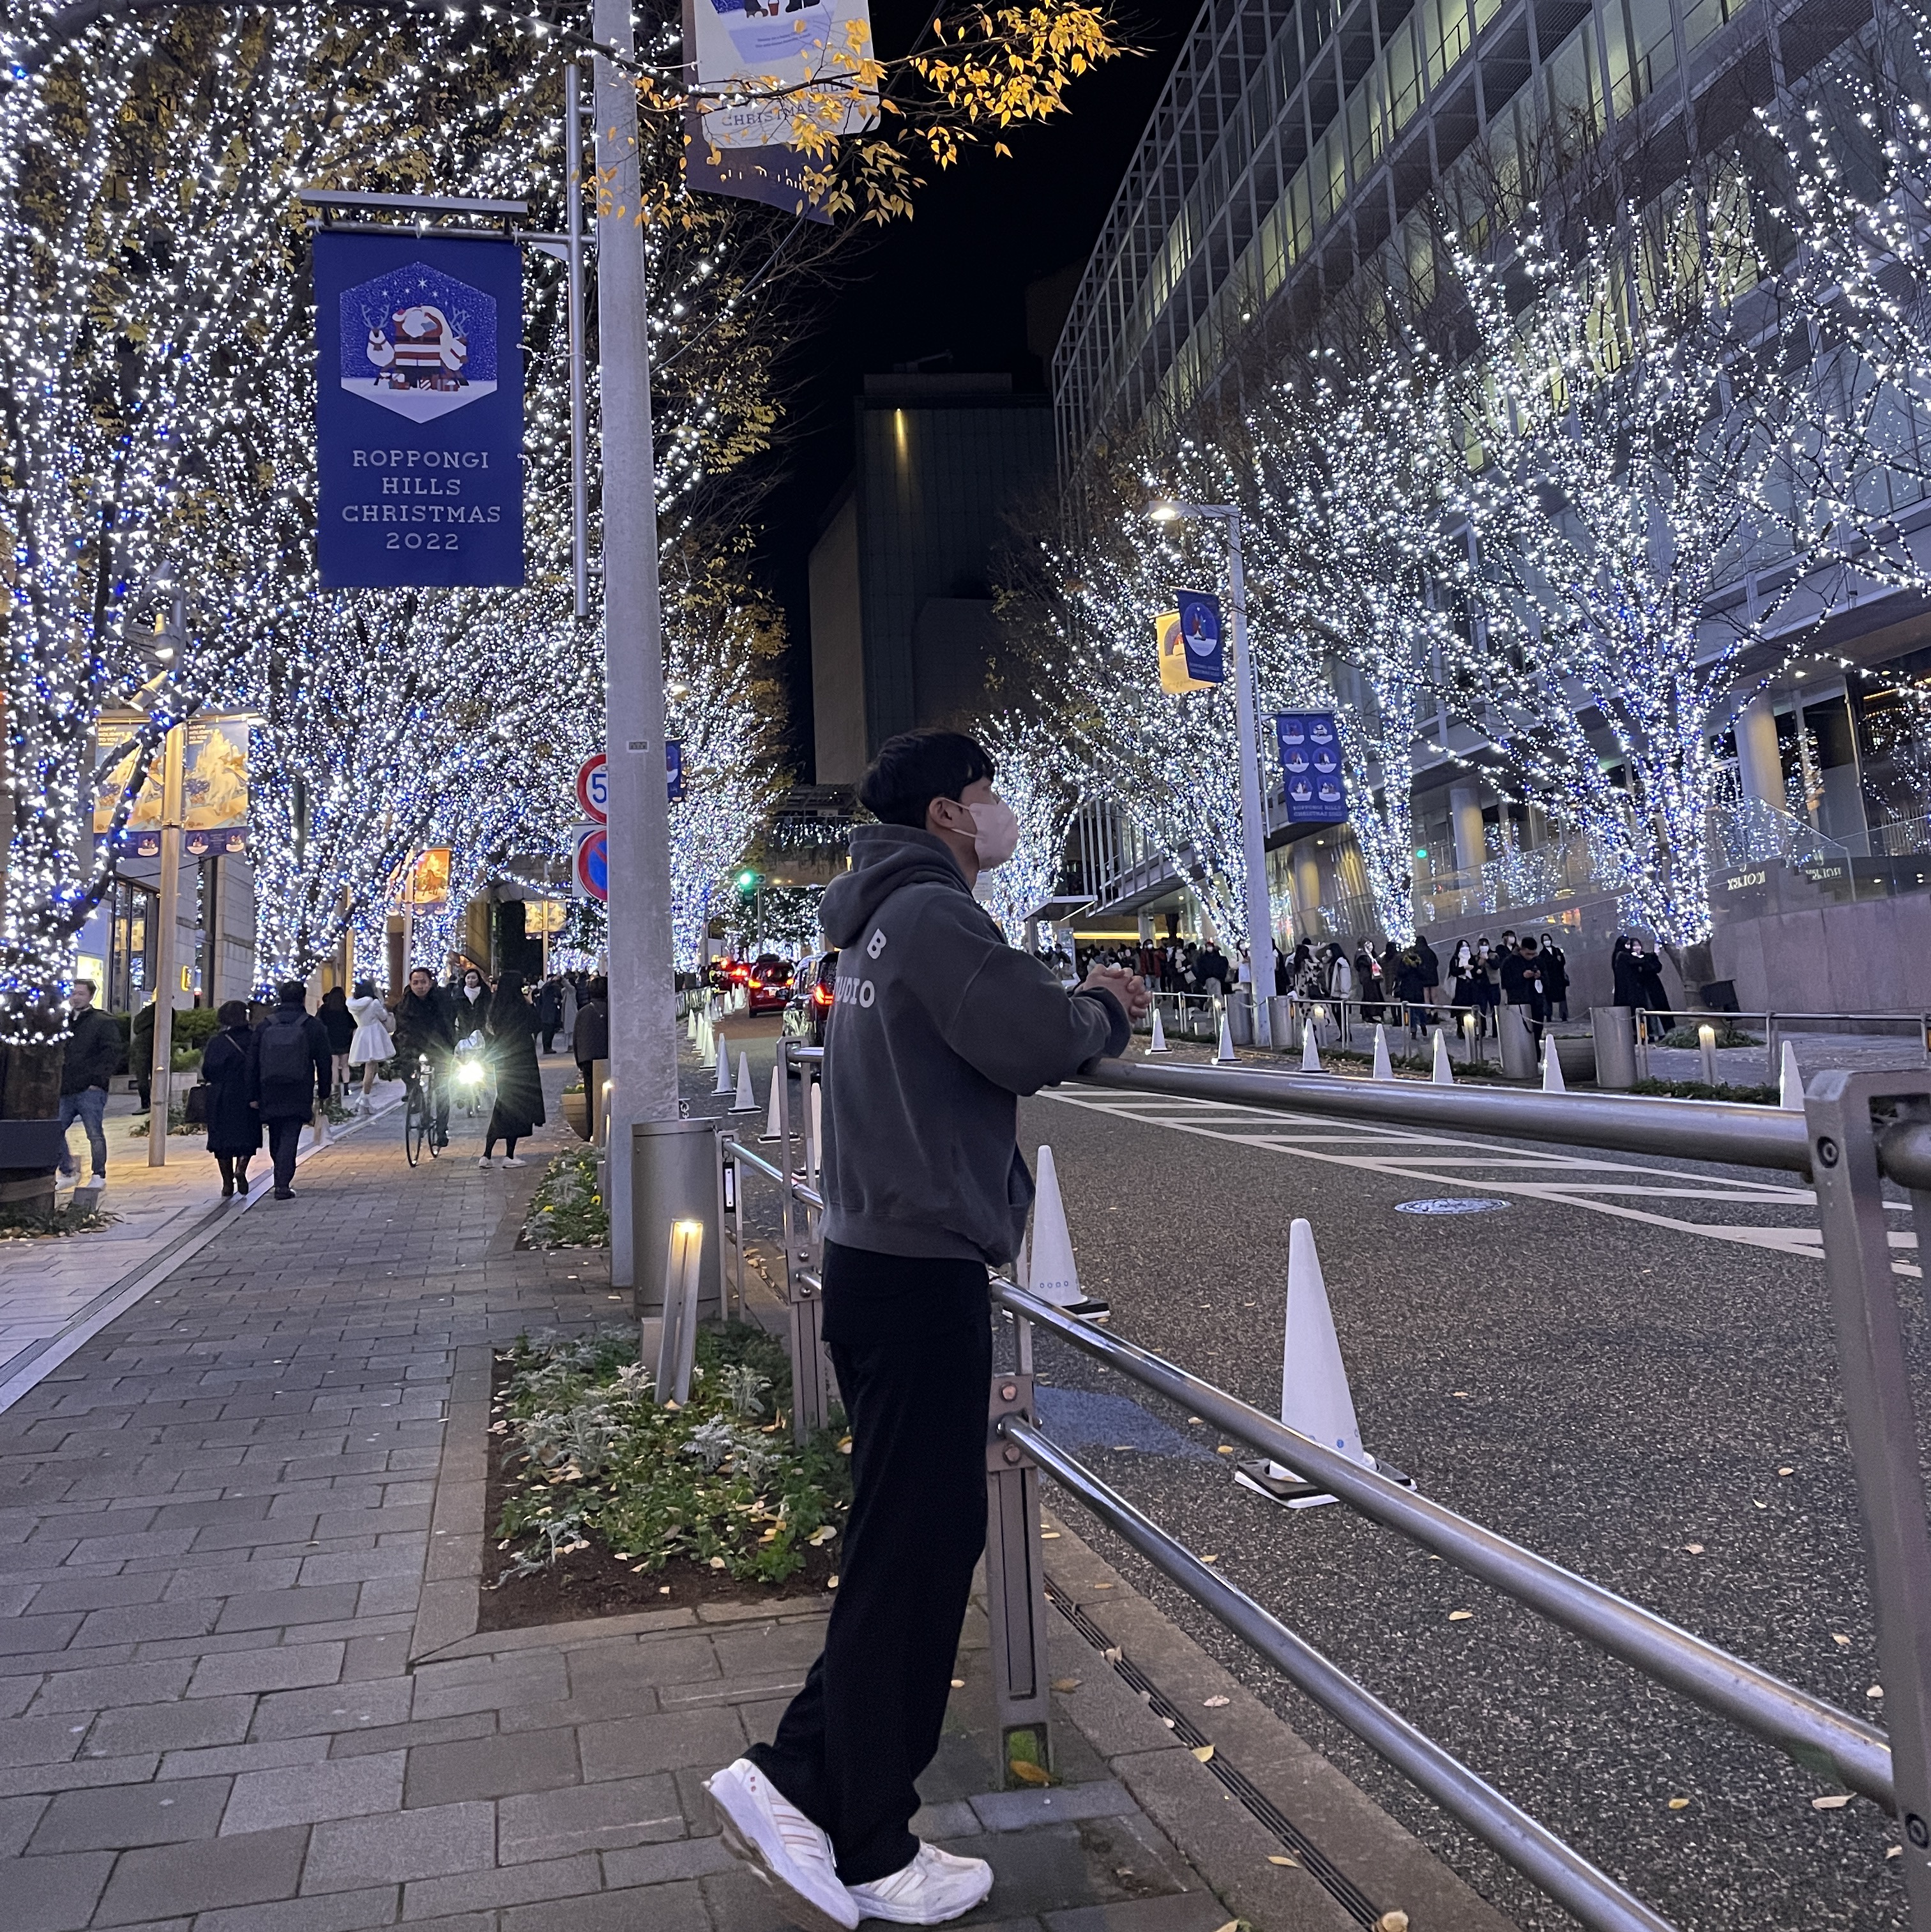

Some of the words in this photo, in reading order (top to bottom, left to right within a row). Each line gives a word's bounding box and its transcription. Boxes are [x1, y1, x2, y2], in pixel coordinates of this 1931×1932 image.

[722, 101, 817, 126] CHRISTMAS
[352, 450, 488, 468] ROPPONGI
[382, 477, 461, 496] HILLS
[342, 505, 501, 523] CHRISTMAS
[386, 532, 458, 550] 2022
[867, 928, 887, 959] B
